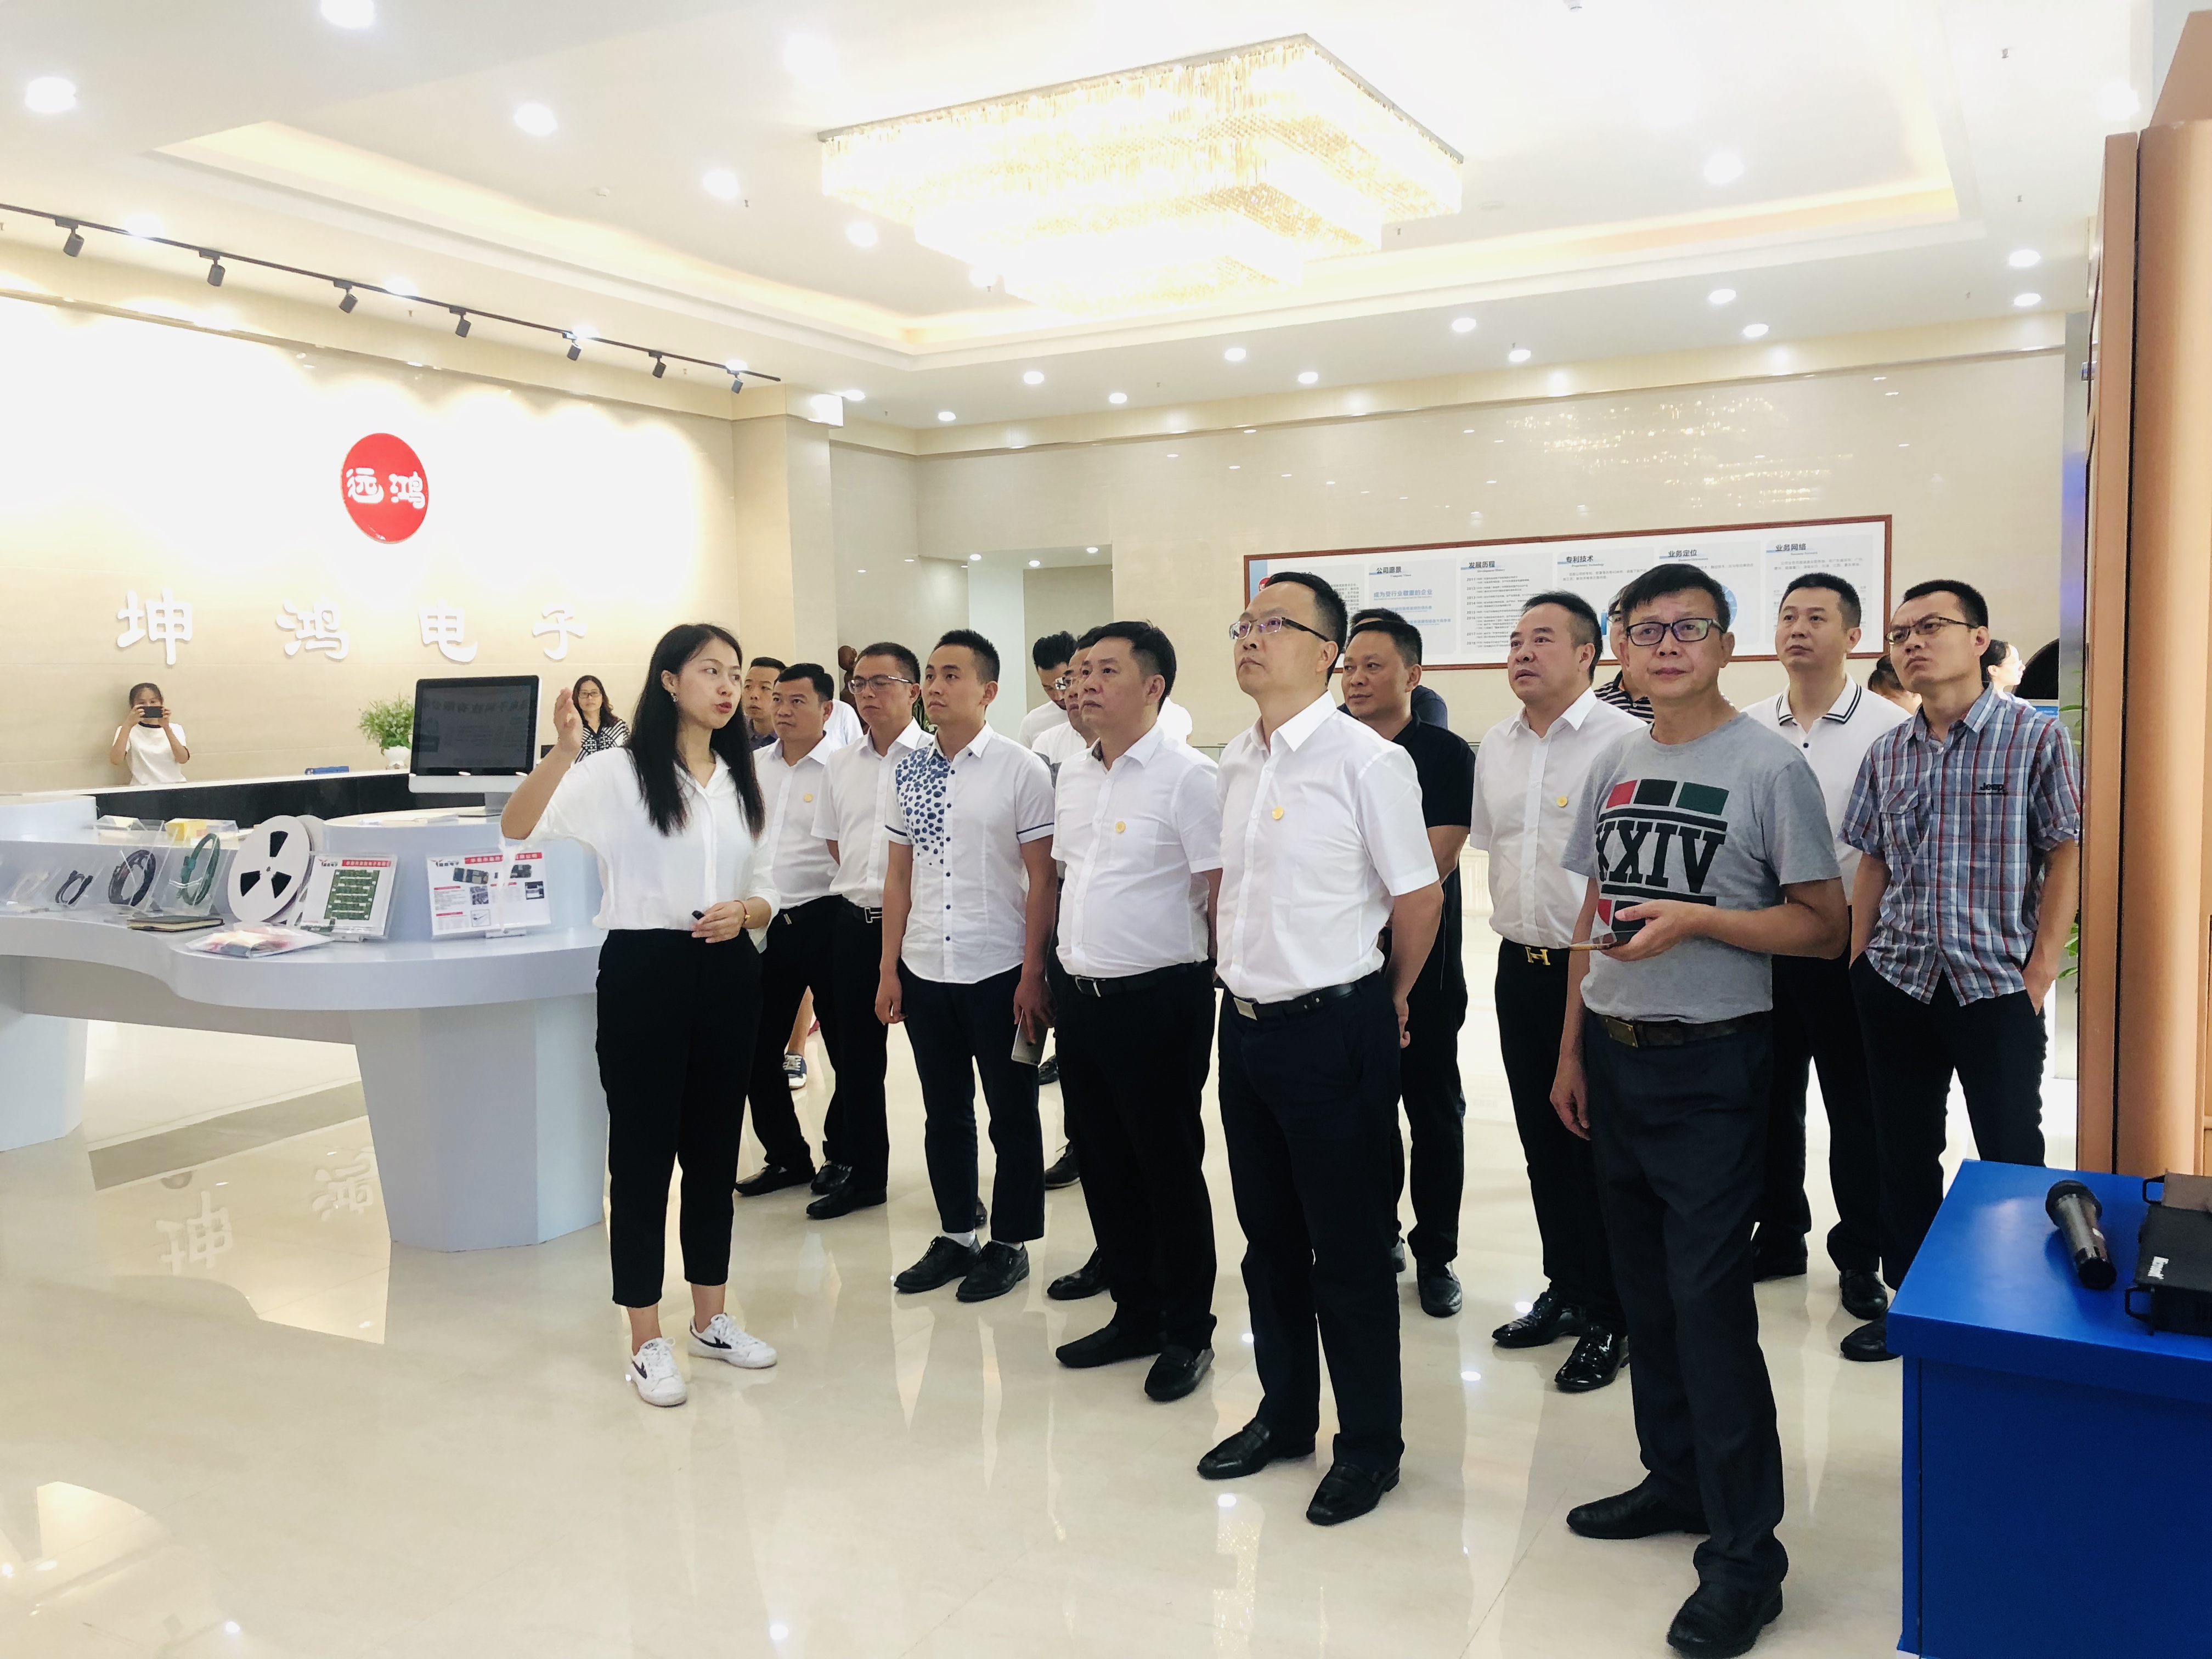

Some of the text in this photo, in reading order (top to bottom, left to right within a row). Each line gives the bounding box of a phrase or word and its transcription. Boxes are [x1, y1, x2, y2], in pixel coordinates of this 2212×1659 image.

[346, 467, 426, 509] 远鸿
[1668, 549, 1697, 557] 业务定位
[1775, 543, 1806, 551] 业务网络
[116, 587, 588, 665] 坤鸿电子
[1979, 782, 2004, 792] Jeep
[1596, 820, 1726, 894] XXIV
